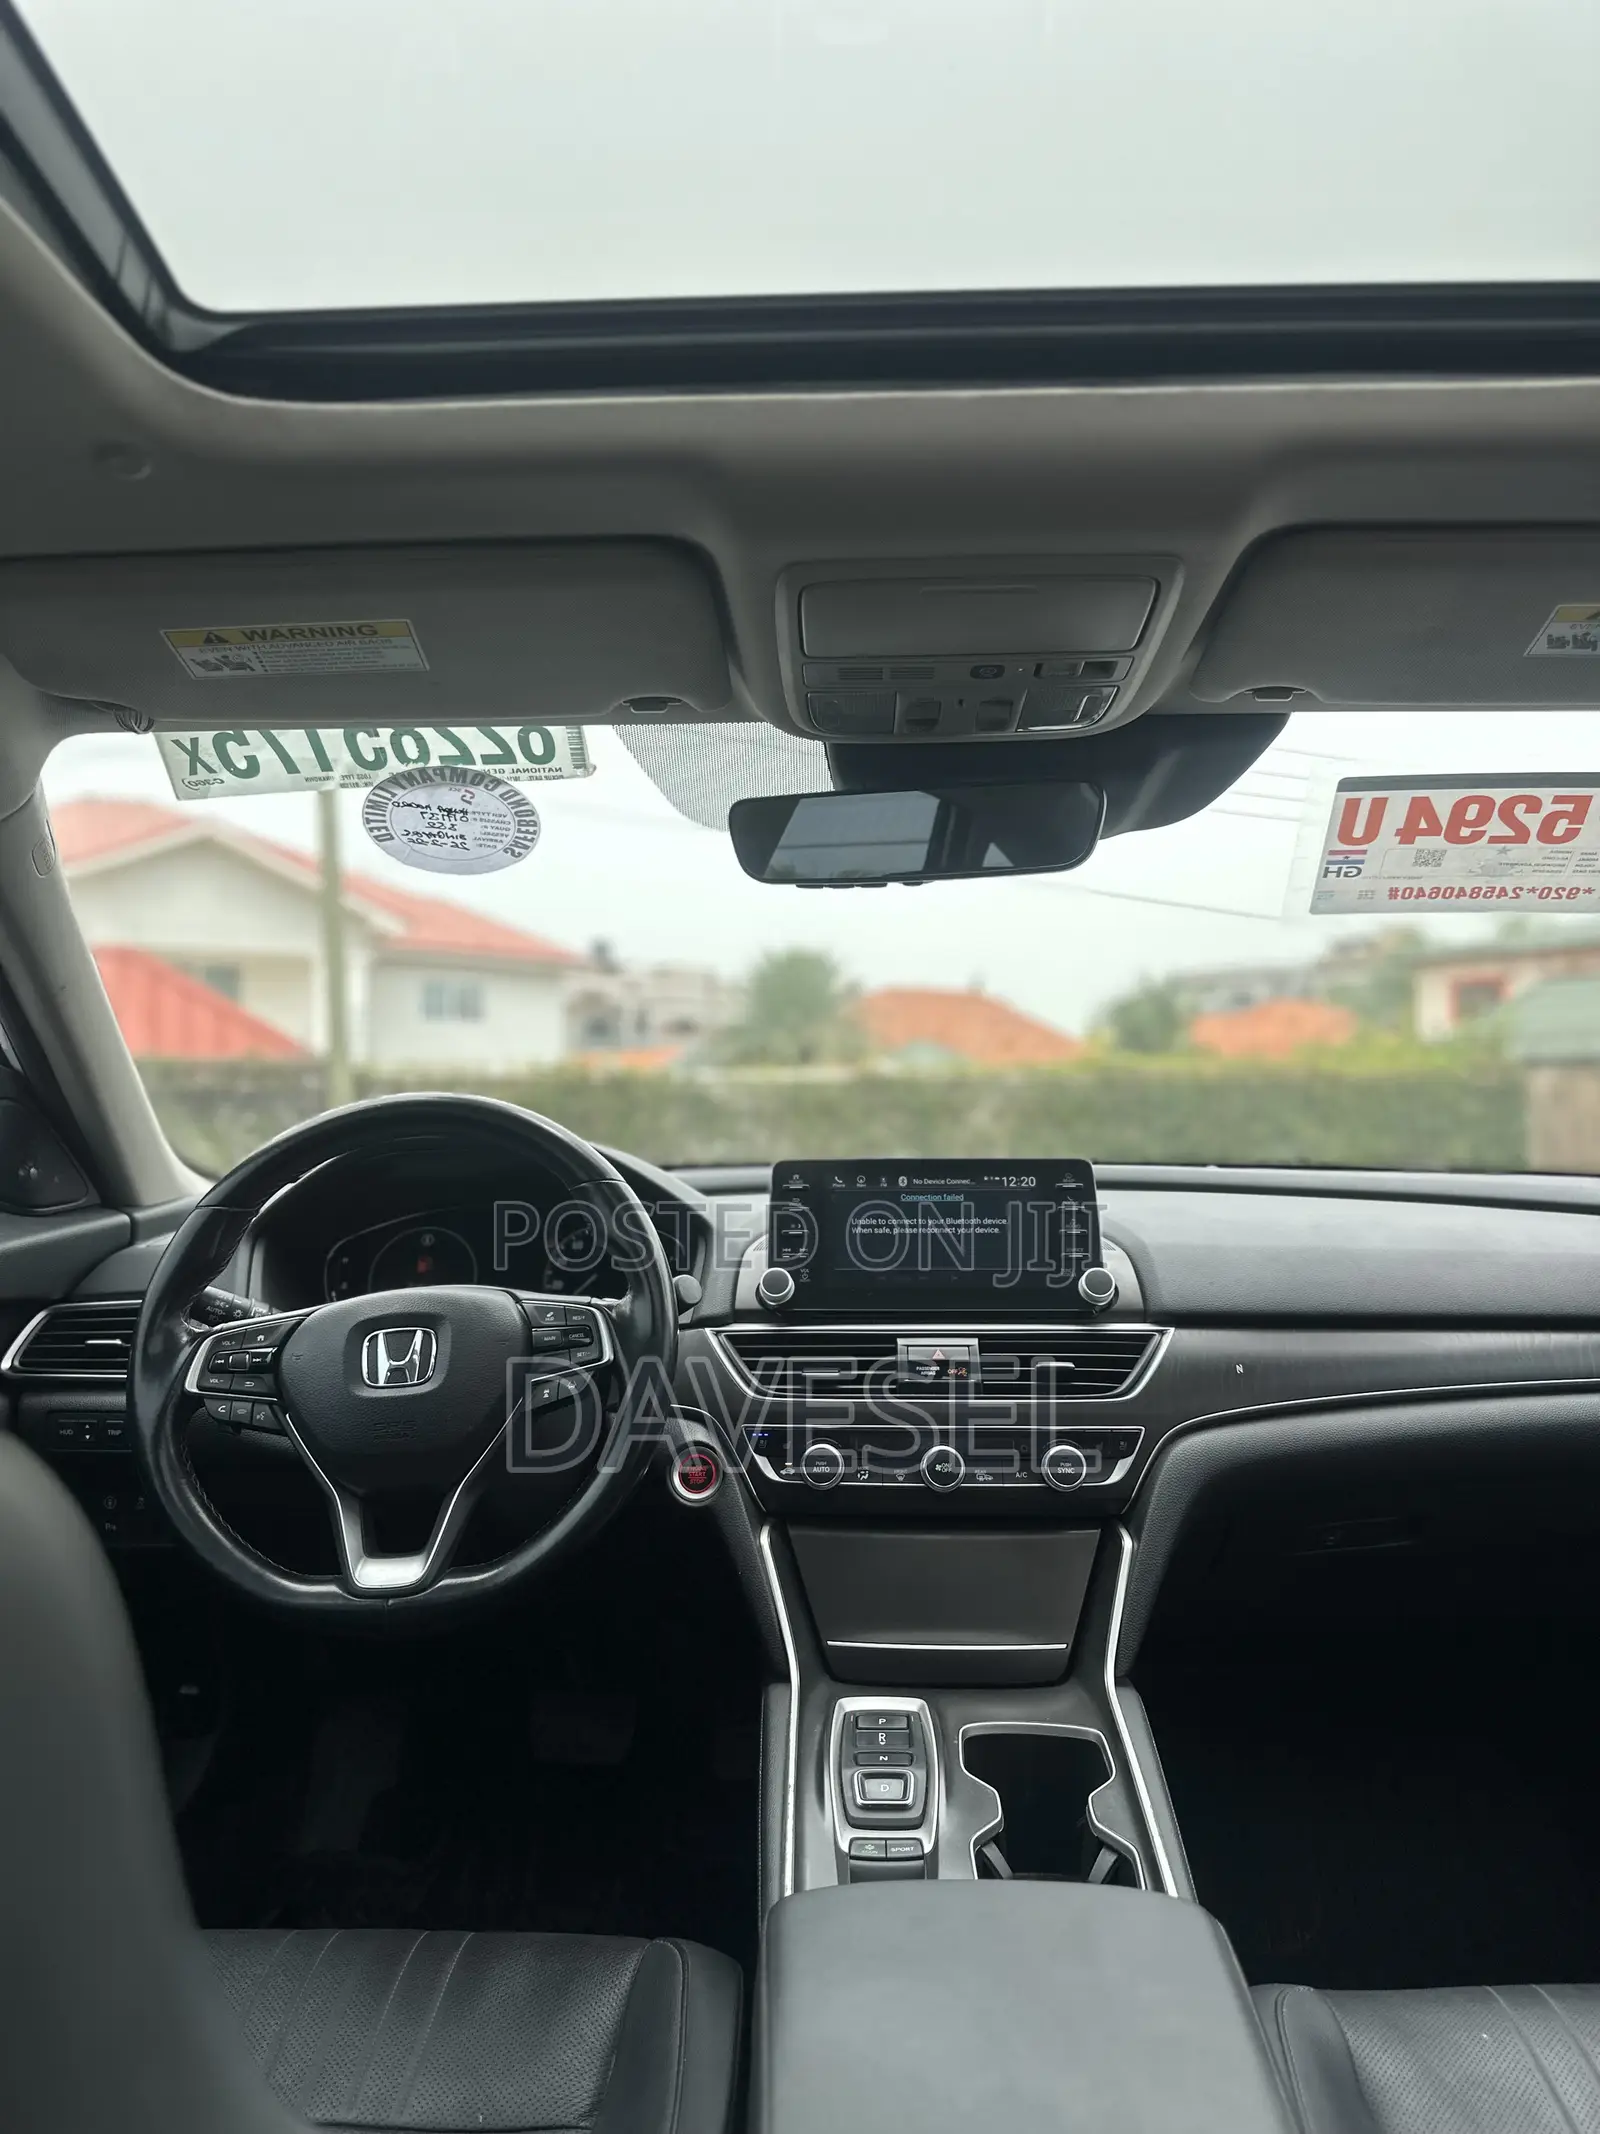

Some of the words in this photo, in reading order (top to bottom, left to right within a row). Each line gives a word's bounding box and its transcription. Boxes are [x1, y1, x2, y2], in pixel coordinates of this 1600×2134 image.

[240, 625, 378, 642] WARNING
[1002, 1176, 1036, 1187] 12:20
[901, 1193, 943, 1201] Connection
[943, 1193, 965, 1201] failed
[928, 1219, 944, 1227] your
[874, 1227, 892, 1235] safe,
[893, 1227, 918, 1236] please
[957, 1228, 974, 1236] your
[1015, 1471, 1028, 1479] A/C
[878, 1732, 886, 1743] R
[880, 1784, 889, 1792] D
